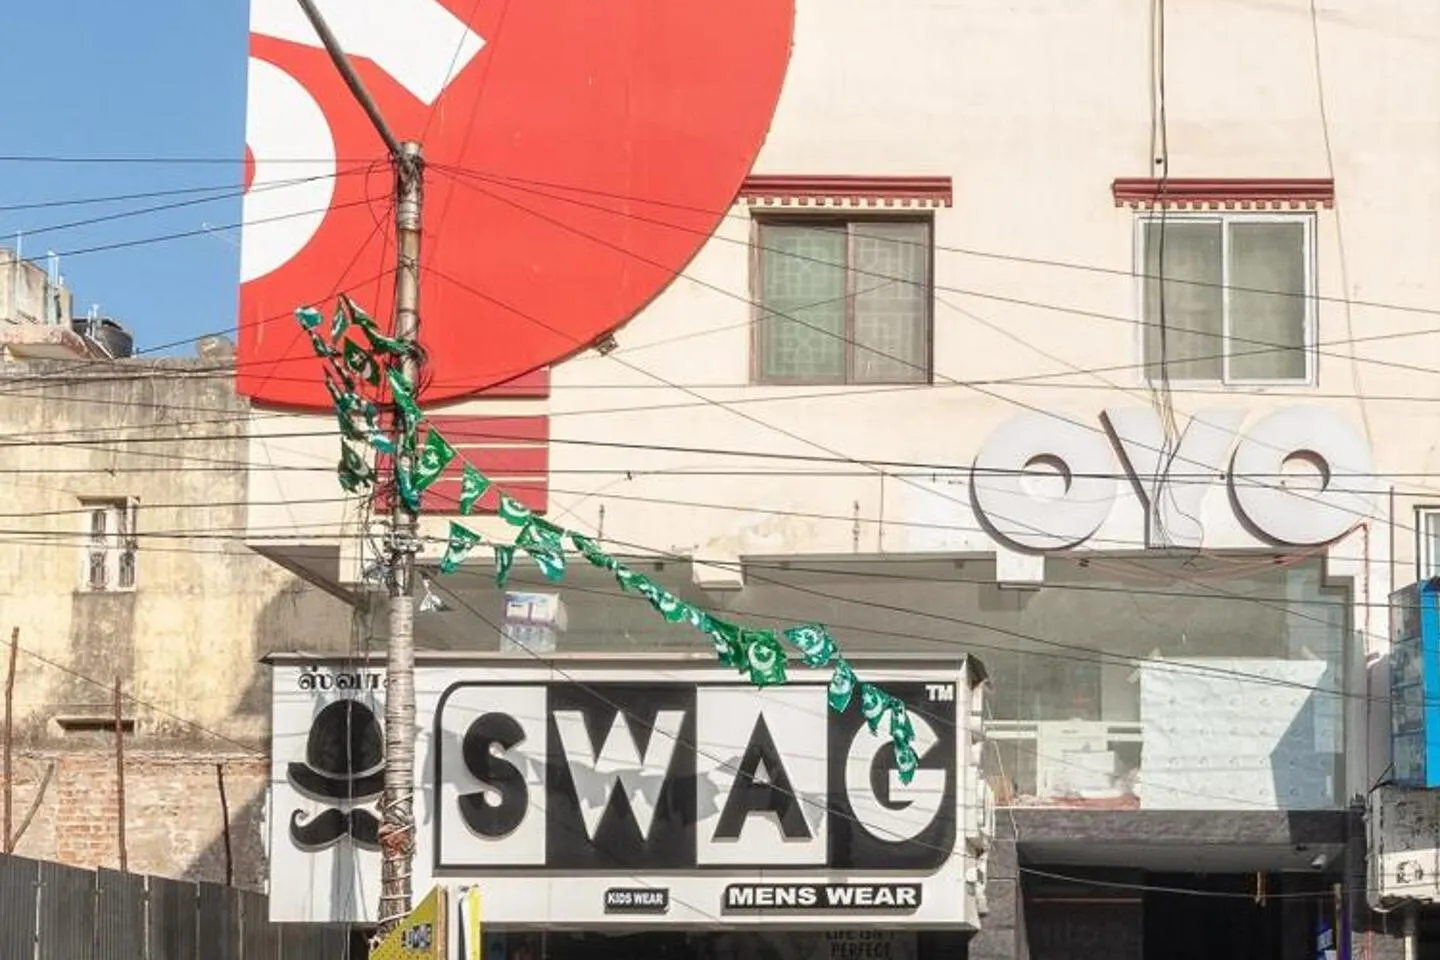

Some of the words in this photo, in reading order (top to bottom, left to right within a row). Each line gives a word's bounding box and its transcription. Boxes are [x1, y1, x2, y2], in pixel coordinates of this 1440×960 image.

[969, 404, 1374, 555] OYO
[299, 665, 391, 690] ஸ்வா
[925, 684, 953, 701] TM
[457, 709, 947, 843] SWAG
[607, 892, 632, 904] KIDS
[633, 892, 663, 904] WEAR
[728, 887, 817, 905] MENS
[826, 887, 917, 905] WEAR
